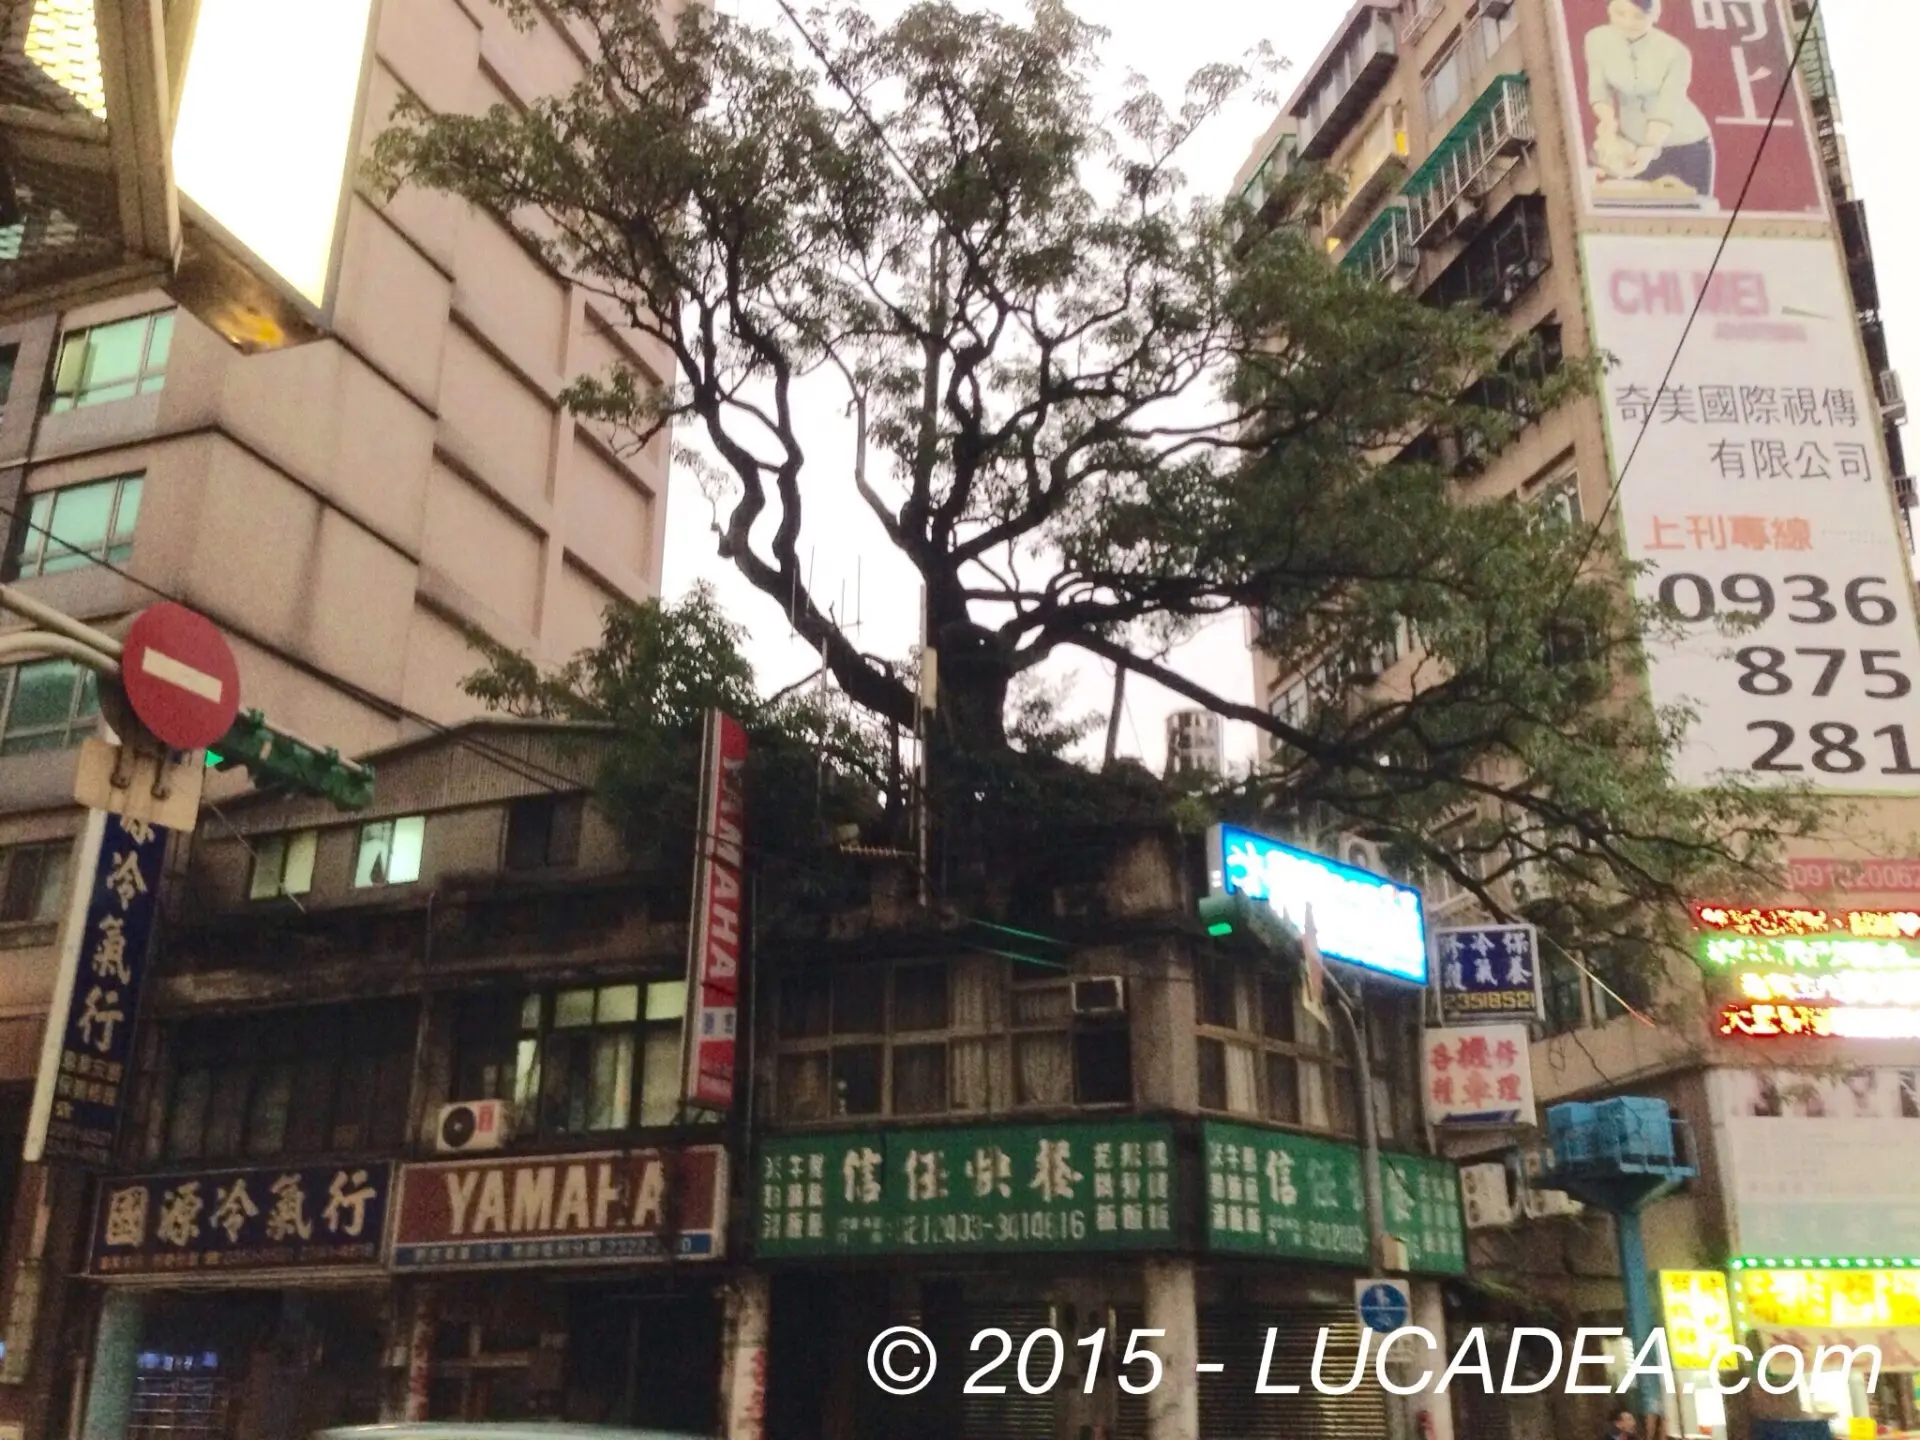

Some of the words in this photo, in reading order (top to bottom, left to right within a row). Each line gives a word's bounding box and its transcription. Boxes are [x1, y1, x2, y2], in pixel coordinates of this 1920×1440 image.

[1614, 383, 1860, 428] 奇美國際視傳
[1707, 437, 1873, 483] 有限公司
[1643, 514, 1814, 551] 上刊專線
[1657, 572, 1898, 627] 0936
[1735, 645, 1912, 700] 875
[1746, 719, 1920, 775] 281
[105, 1169, 378, 1247] 國源冷氣行
[446, 1160, 665, 1236] YAMAHA
